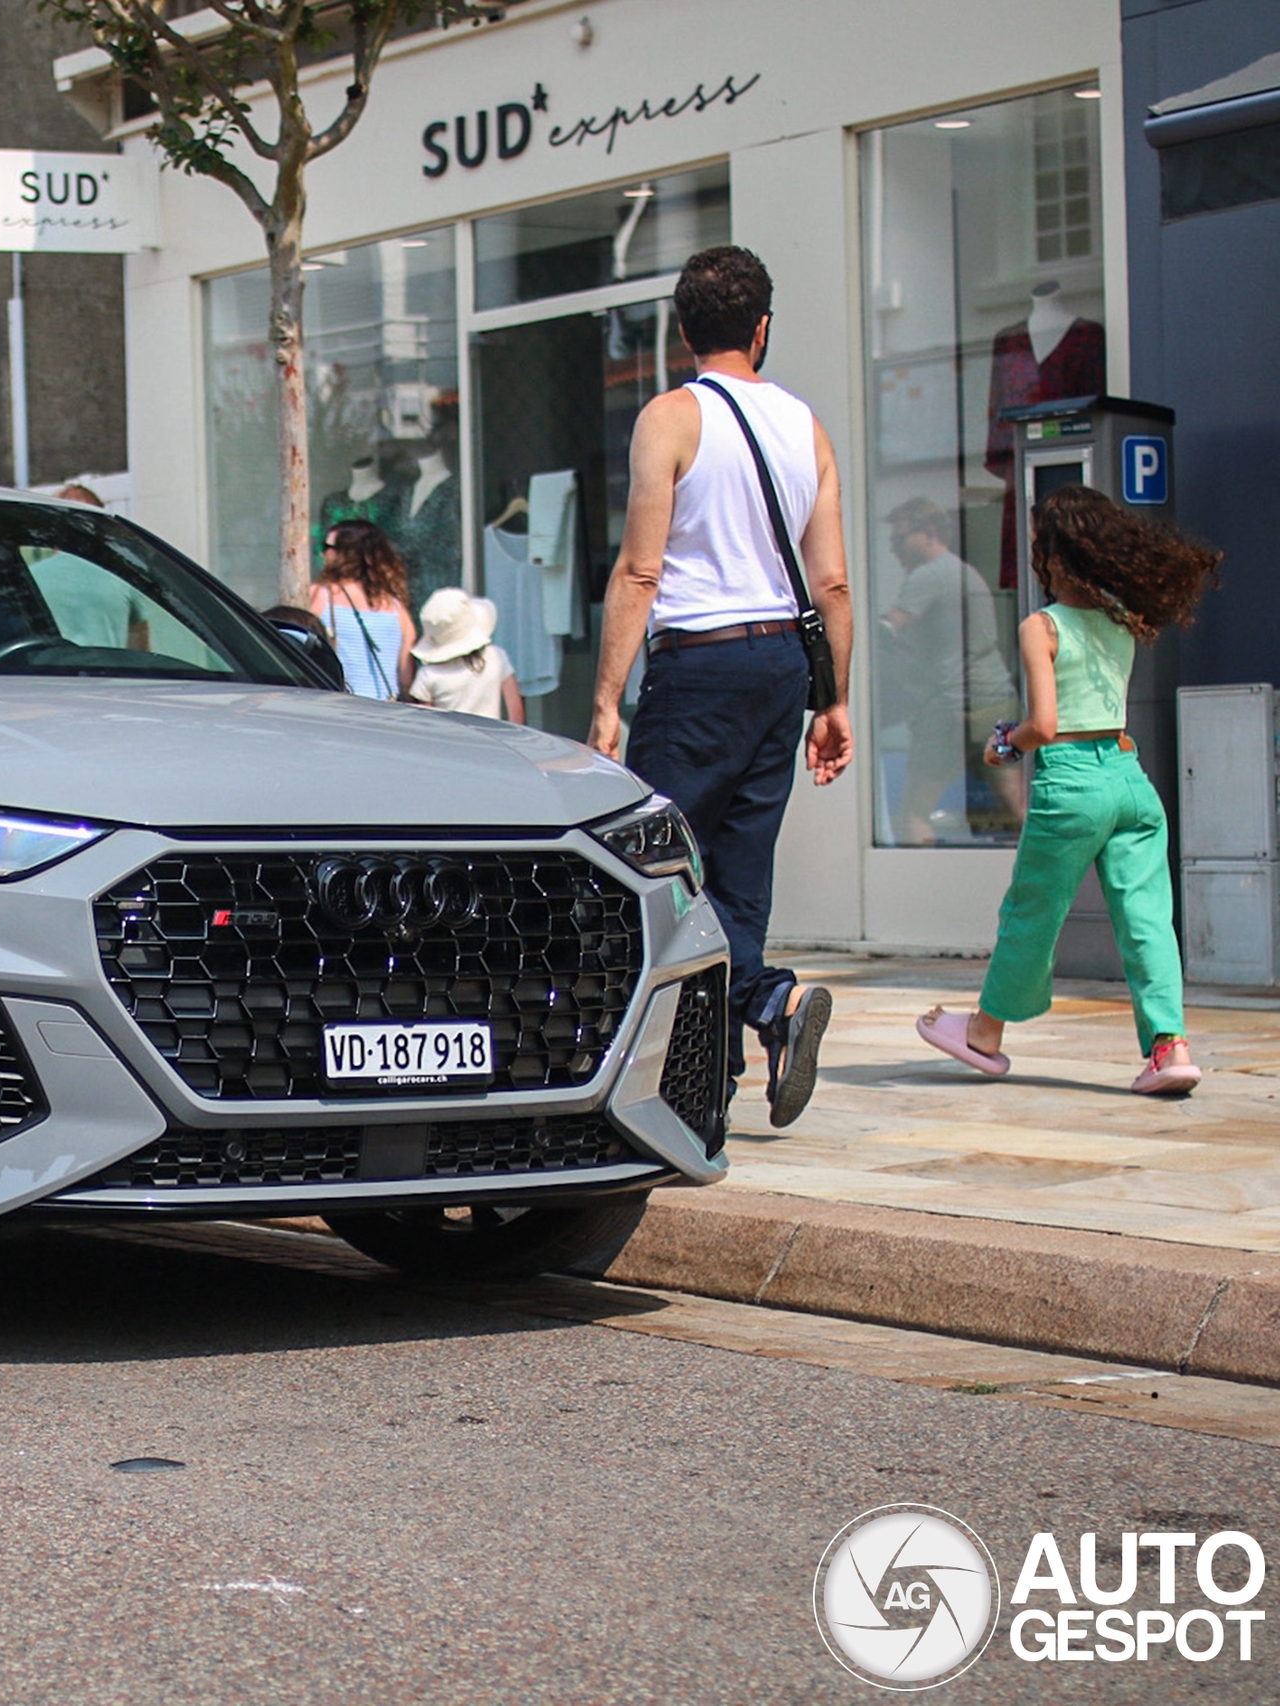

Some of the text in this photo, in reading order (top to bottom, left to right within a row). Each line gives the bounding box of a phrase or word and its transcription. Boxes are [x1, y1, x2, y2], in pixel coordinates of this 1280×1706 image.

[549, 74, 761, 154] express
[2, 216, 130, 236] express
[1135, 446, 1158, 494] P
